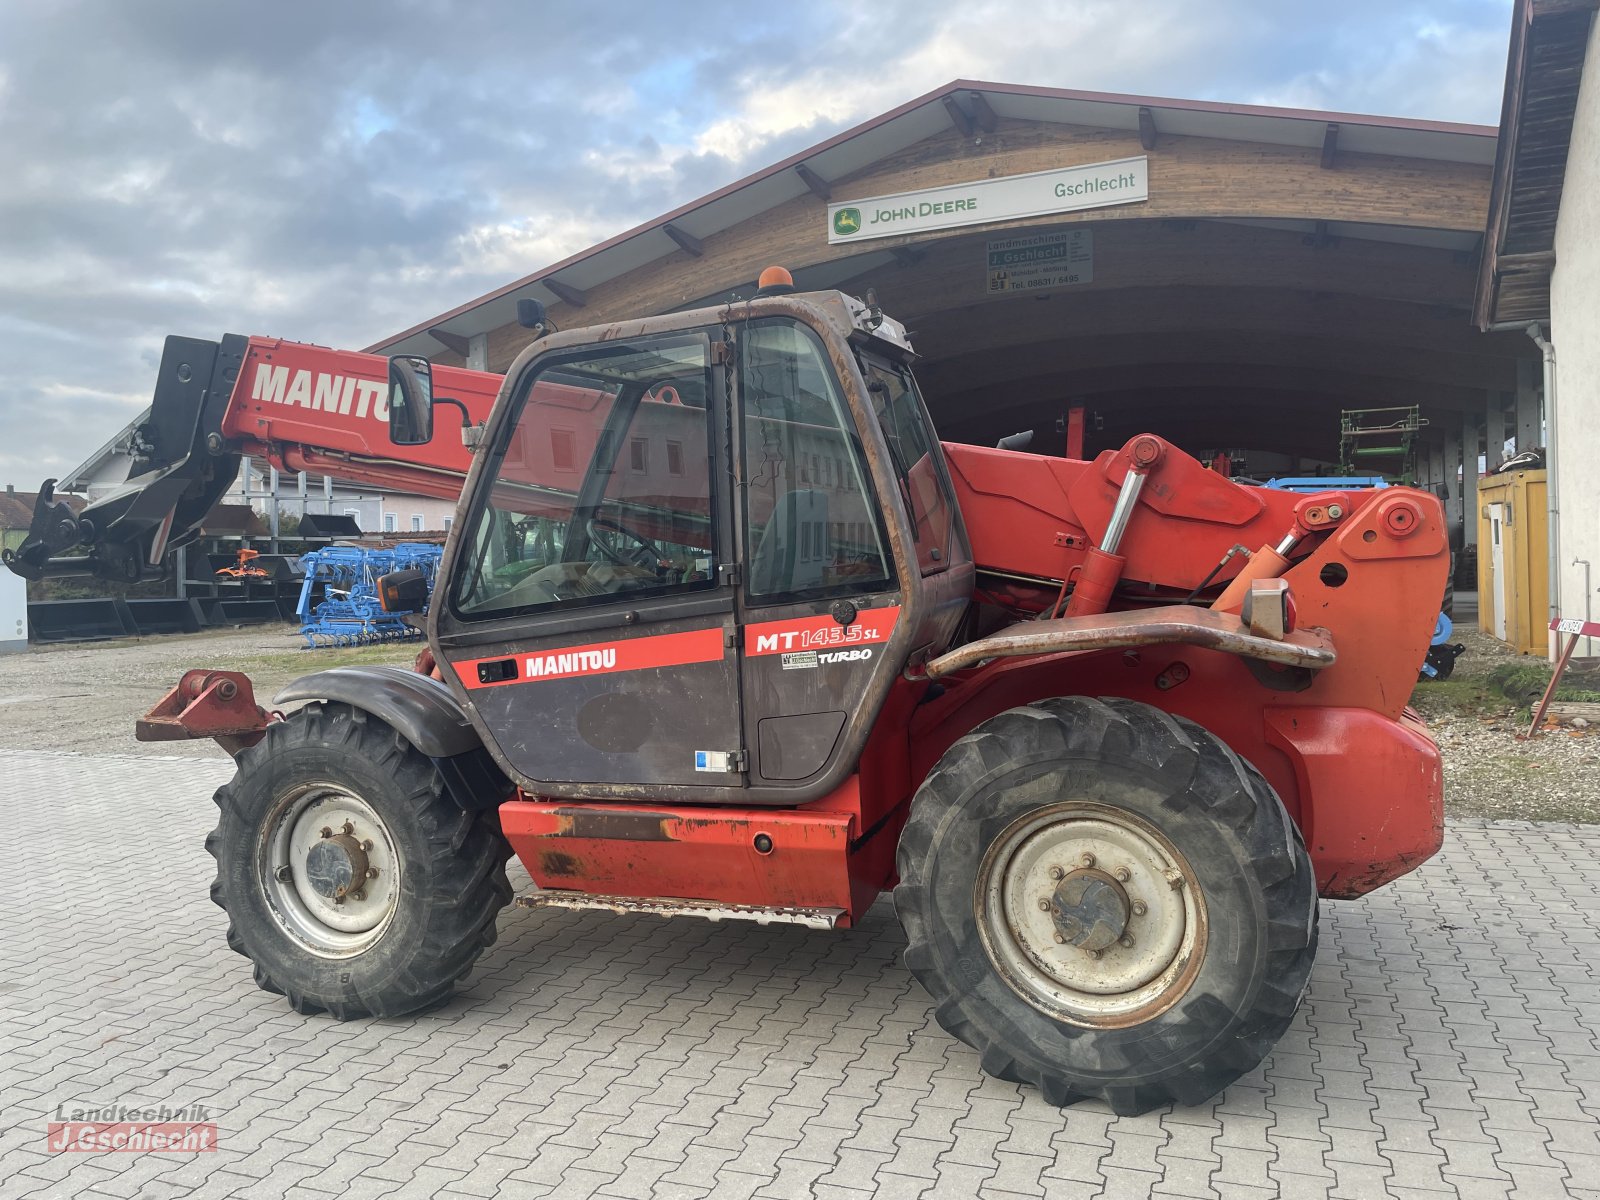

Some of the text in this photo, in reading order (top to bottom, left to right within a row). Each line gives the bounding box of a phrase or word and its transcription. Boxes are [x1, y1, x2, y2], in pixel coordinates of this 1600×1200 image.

[1054, 173, 1136, 198] Gschlecht
[870, 197, 977, 224] JOHN DEERE
[988, 233, 1067, 250] Landmaschinen
[991, 256, 1001, 265] J.
[1004, 247, 1064, 263] Gschlecht
[1011, 281, 1026, 289] Tel.
[526, 648, 616, 677] MANITOU
[818, 649, 872, 664] TURBO
